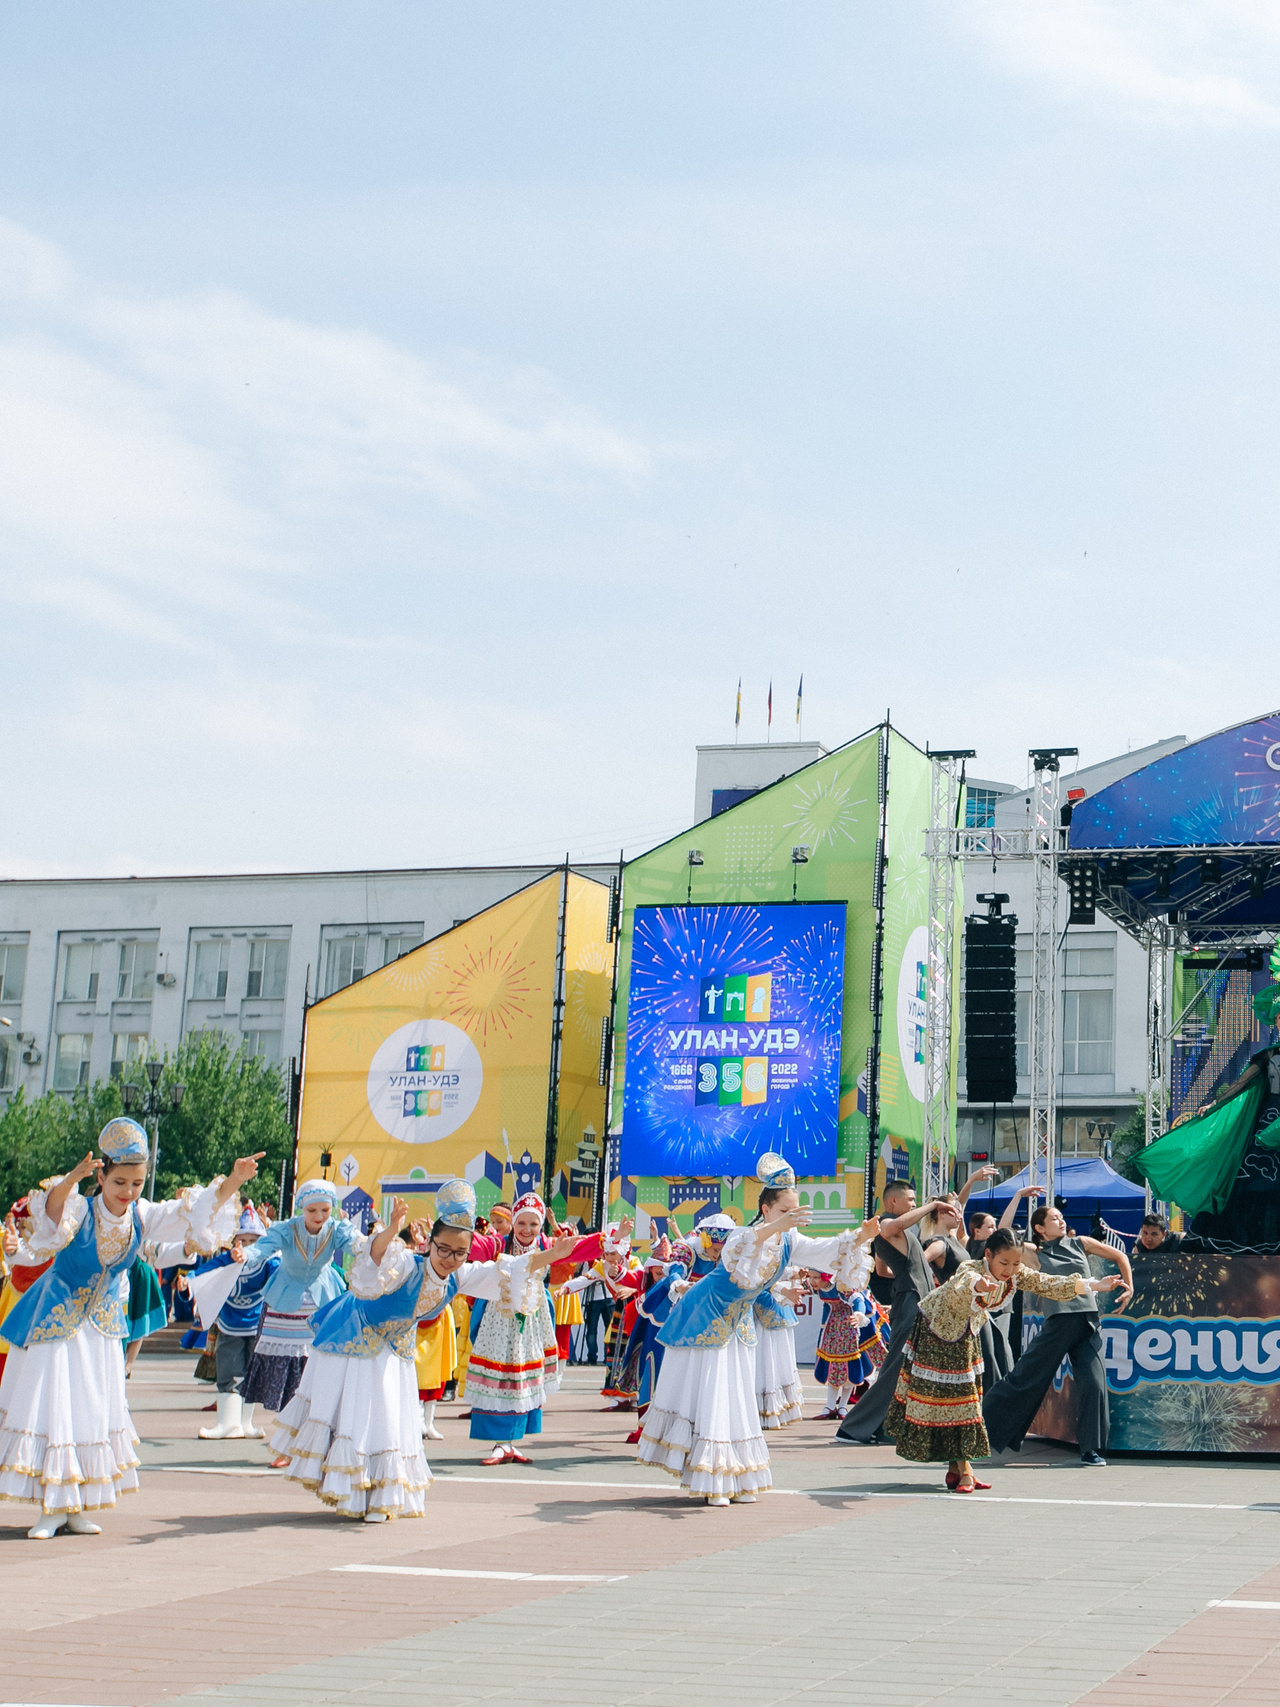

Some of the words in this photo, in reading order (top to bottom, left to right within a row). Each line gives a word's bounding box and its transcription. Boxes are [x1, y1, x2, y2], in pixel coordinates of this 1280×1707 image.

[668, 1028, 800, 1054] УЛАН-УДЭ
[669, 1064, 693, 1076] 1666
[770, 1063, 798, 1075] 2022
[389, 1074, 460, 1087] УЛАН-УДЭ
[698, 1062, 766, 1093] 356
